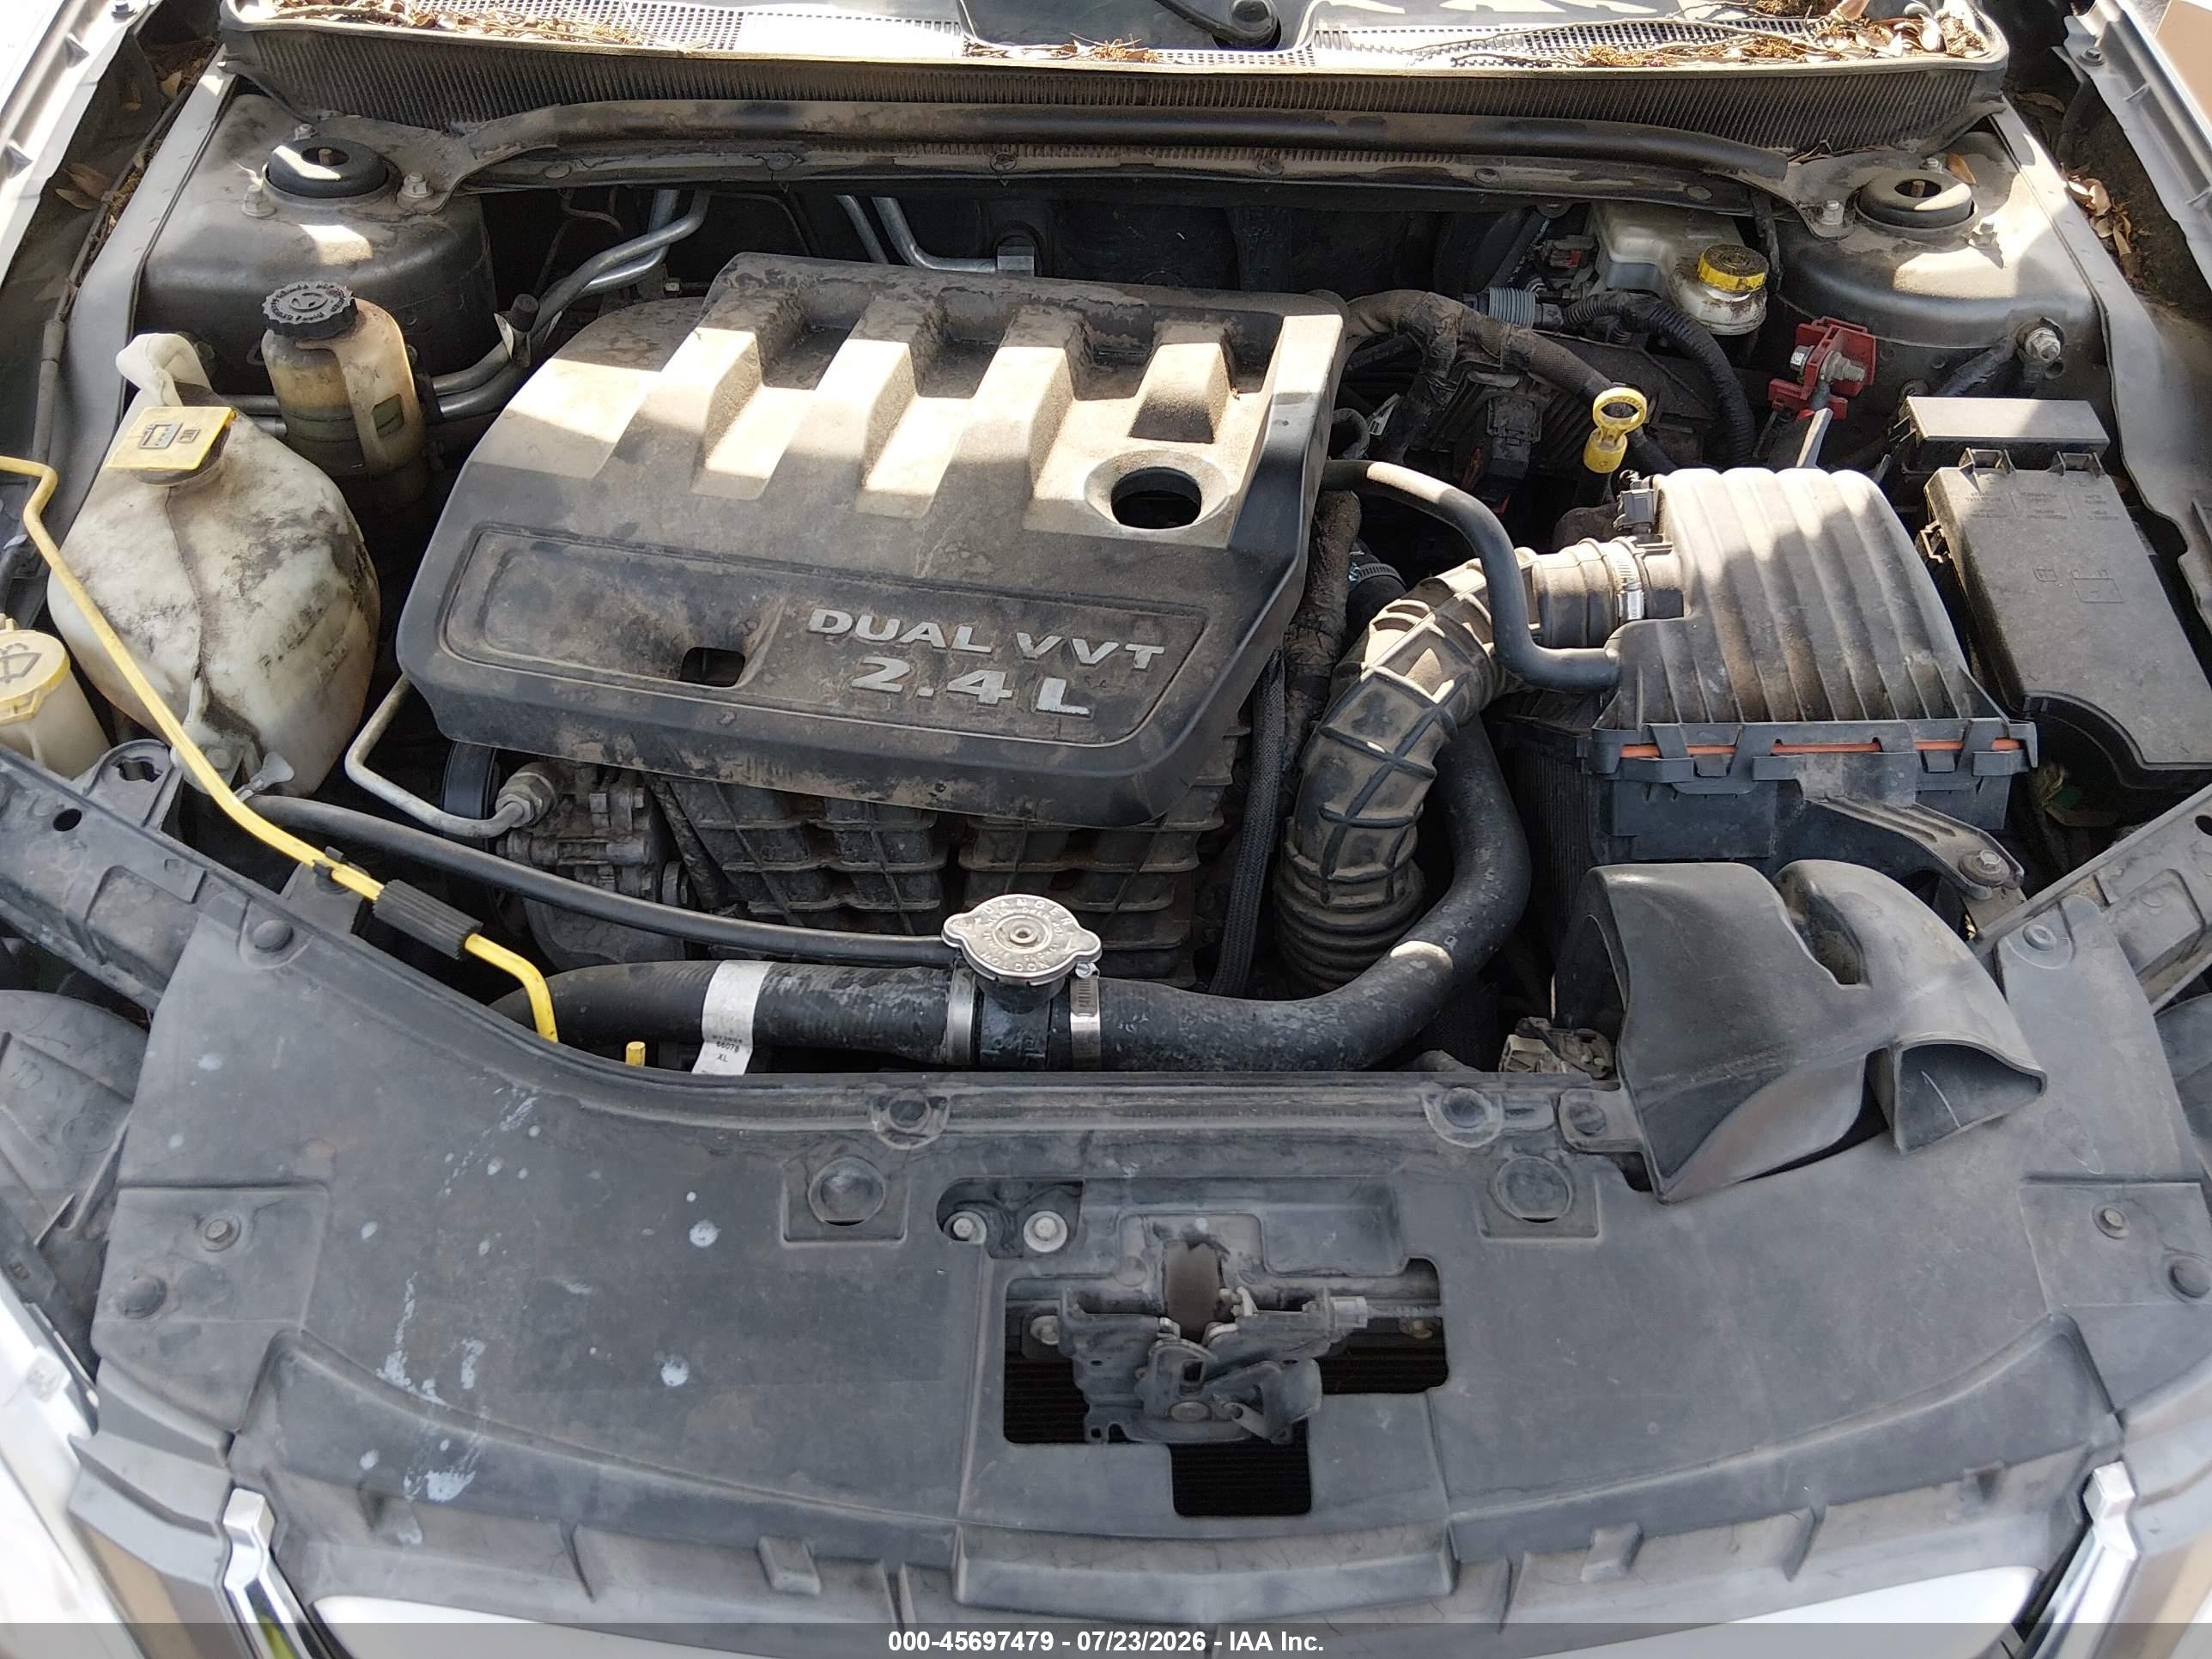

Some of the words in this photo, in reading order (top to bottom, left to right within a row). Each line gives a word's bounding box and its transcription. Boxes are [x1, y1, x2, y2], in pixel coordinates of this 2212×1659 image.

[808, 608, 993, 653] DUAL
[1015, 632, 1165, 670] VVT
[851, 656, 1013, 706] 2.4
[1035, 677, 1092, 717] L
[981, 898, 1073, 927] DANGER
